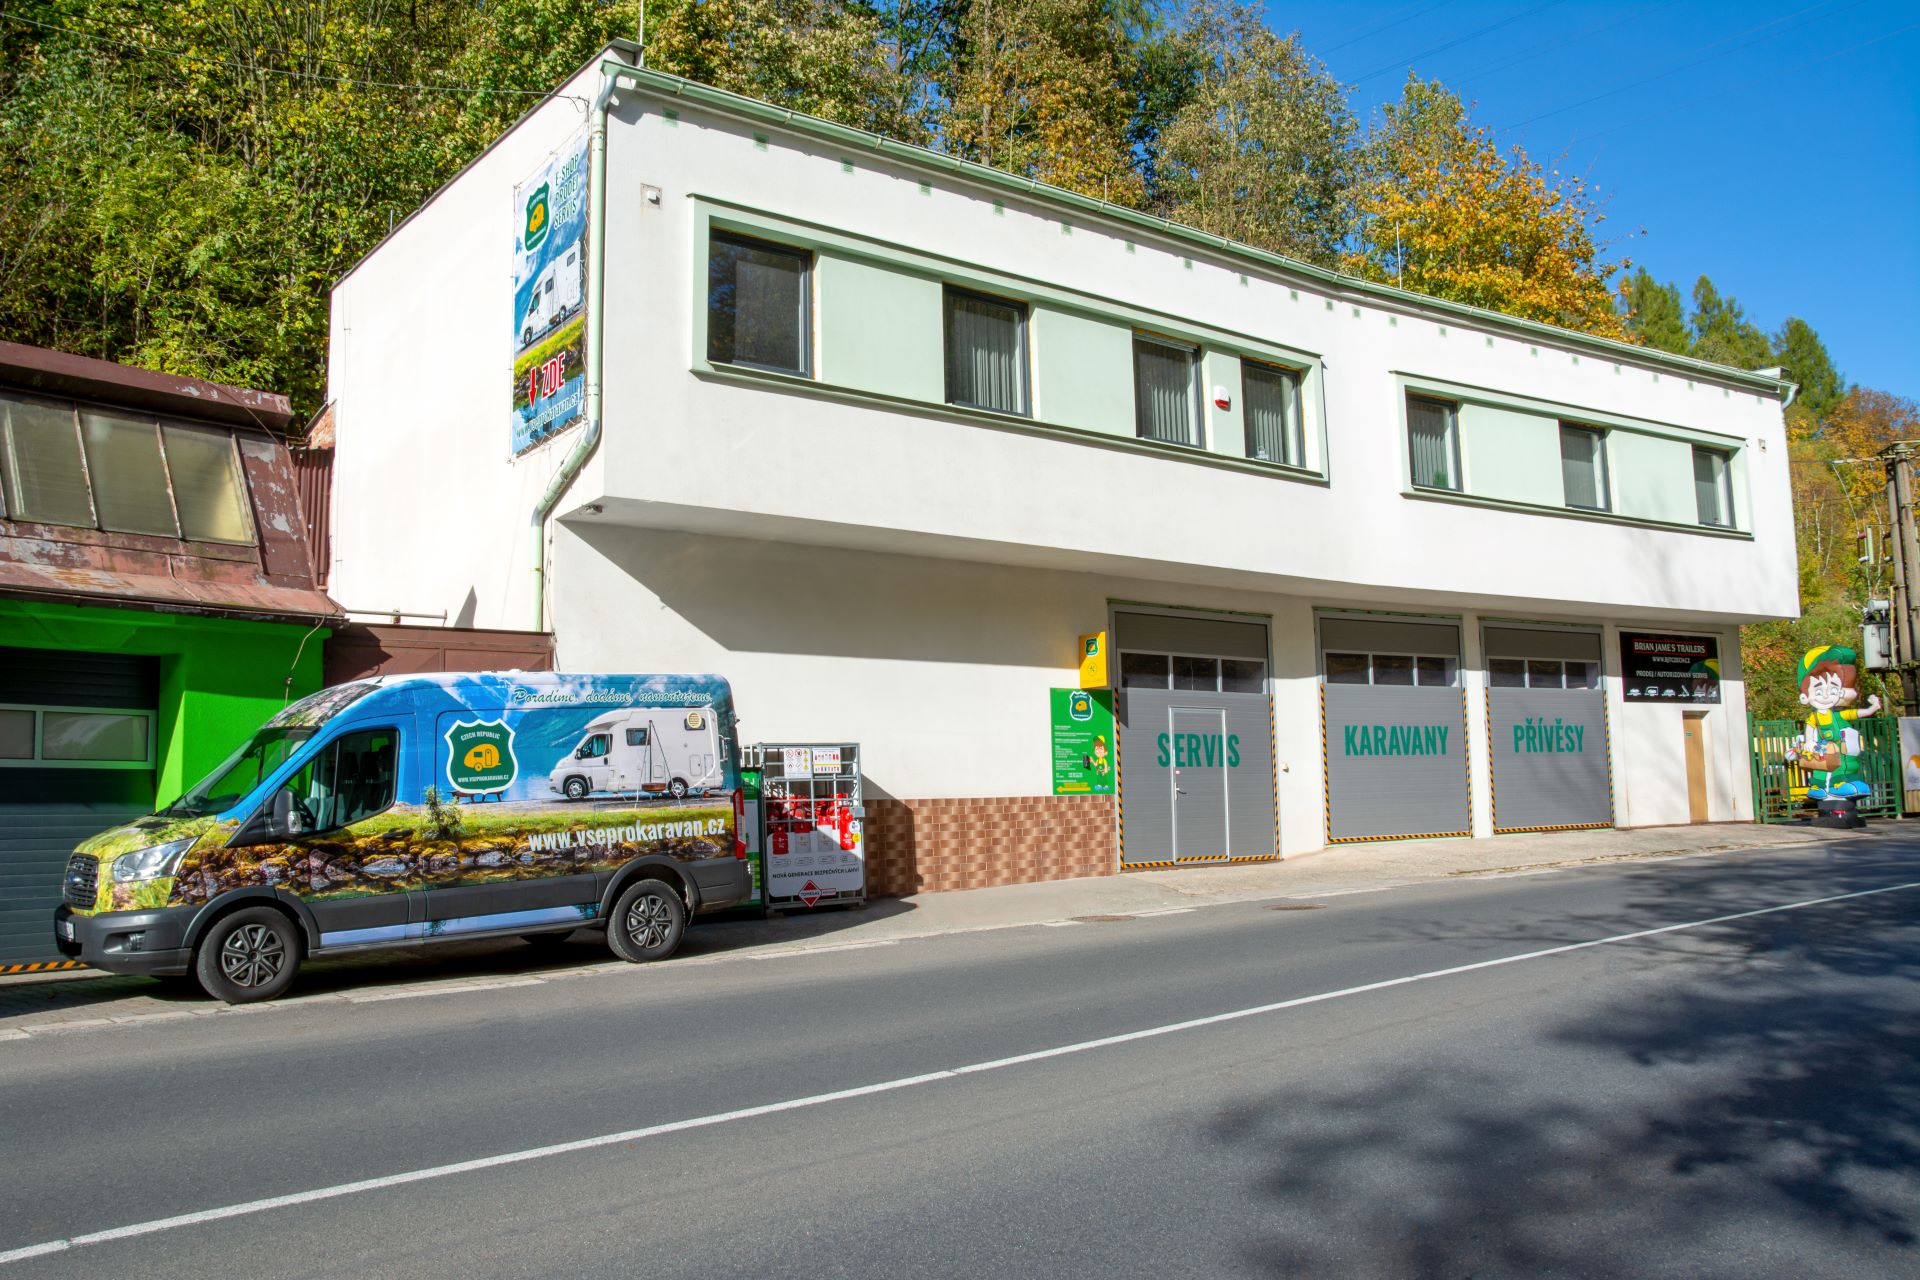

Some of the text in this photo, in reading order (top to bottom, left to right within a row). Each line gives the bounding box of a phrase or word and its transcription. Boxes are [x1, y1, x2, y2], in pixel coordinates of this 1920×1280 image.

[555, 153, 579, 187] E-SHOP
[554, 197, 577, 229] SERVIS
[541, 351, 566, 400] ZDE
[1634, 642, 1705, 653] BRIAN JAMES TRAILERS
[460, 730, 501, 741] CZECH REPUBLIC
[1157, 732, 1240, 768] SERVIS
[1344, 725, 1449, 756] KARAVANY
[1513, 717, 1585, 753] PŘÍVĚSY
[528, 818, 726, 852] www.vseprokaravan.cz
